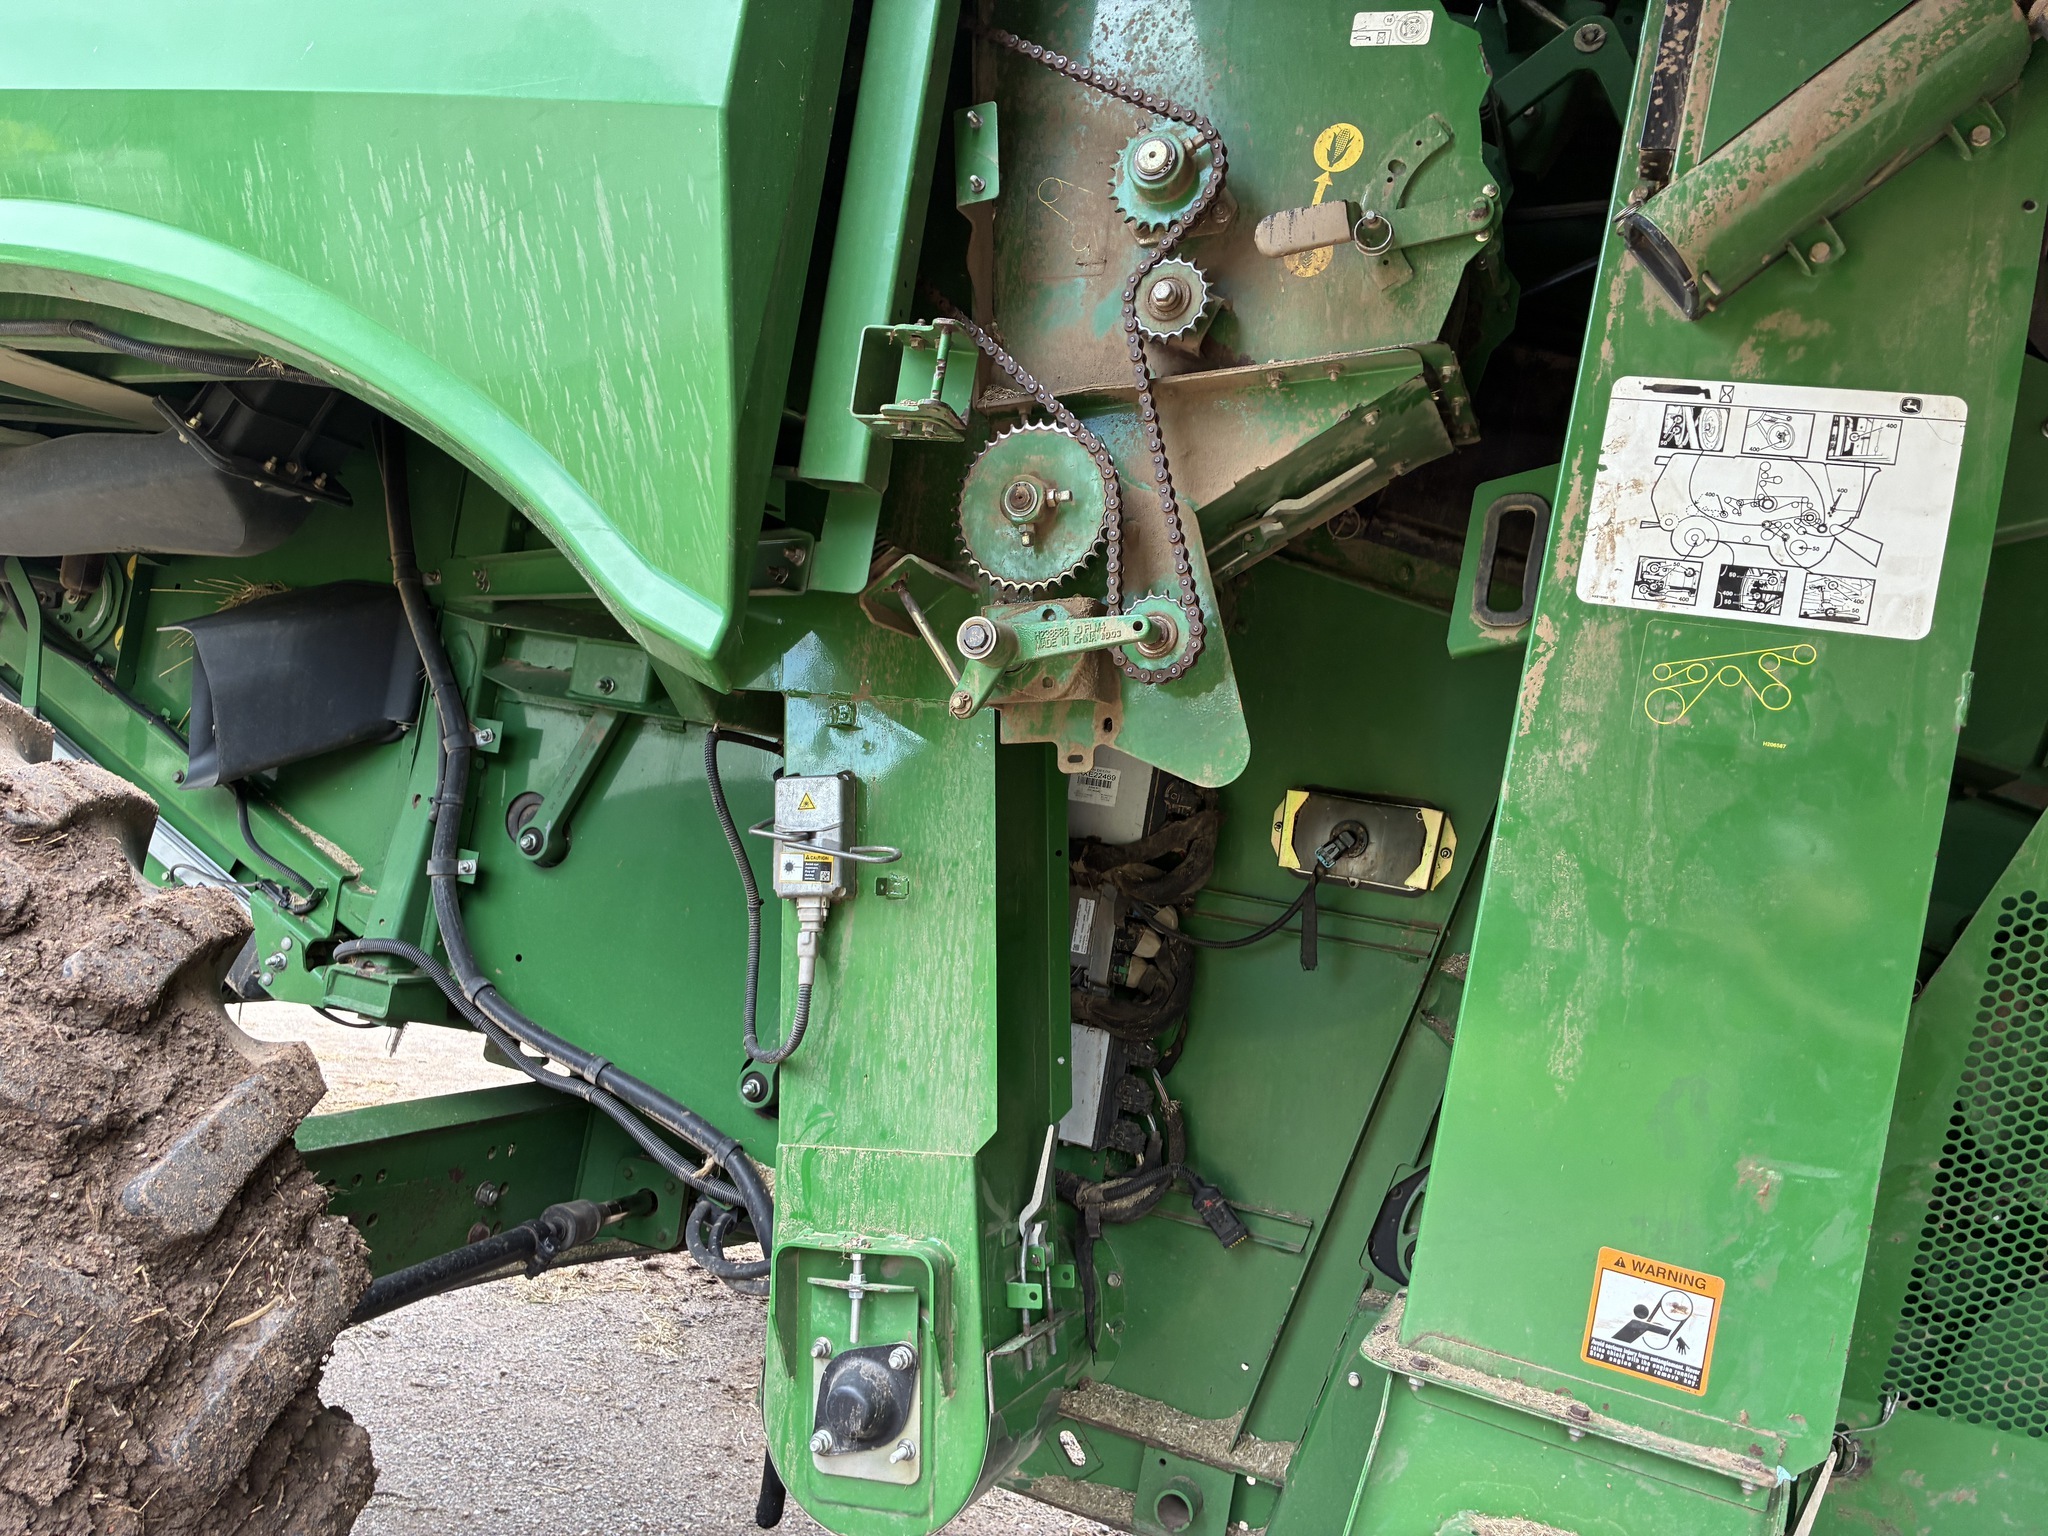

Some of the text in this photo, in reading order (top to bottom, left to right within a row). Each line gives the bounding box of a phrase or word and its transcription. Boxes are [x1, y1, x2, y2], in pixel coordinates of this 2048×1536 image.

[1036, 637, 1057, 650] MADE
[1062, 636, 1069, 646] IN
[1074, 632, 1098, 644] CHINA
[1078, 771, 1116, 781] XE22469
[1632, 1260, 1706, 1290] WARNING
[1591, 1338, 1605, 1347] Avoid
[1590, 1350, 1698, 1387] Stop engine and remove key.
[1591, 1345, 1606, 1353] raise
[1607, 1350, 1625, 1359] shield
[1652, 1363, 1673, 1373] engine
[1674, 1370, 1699, 1381] running.
